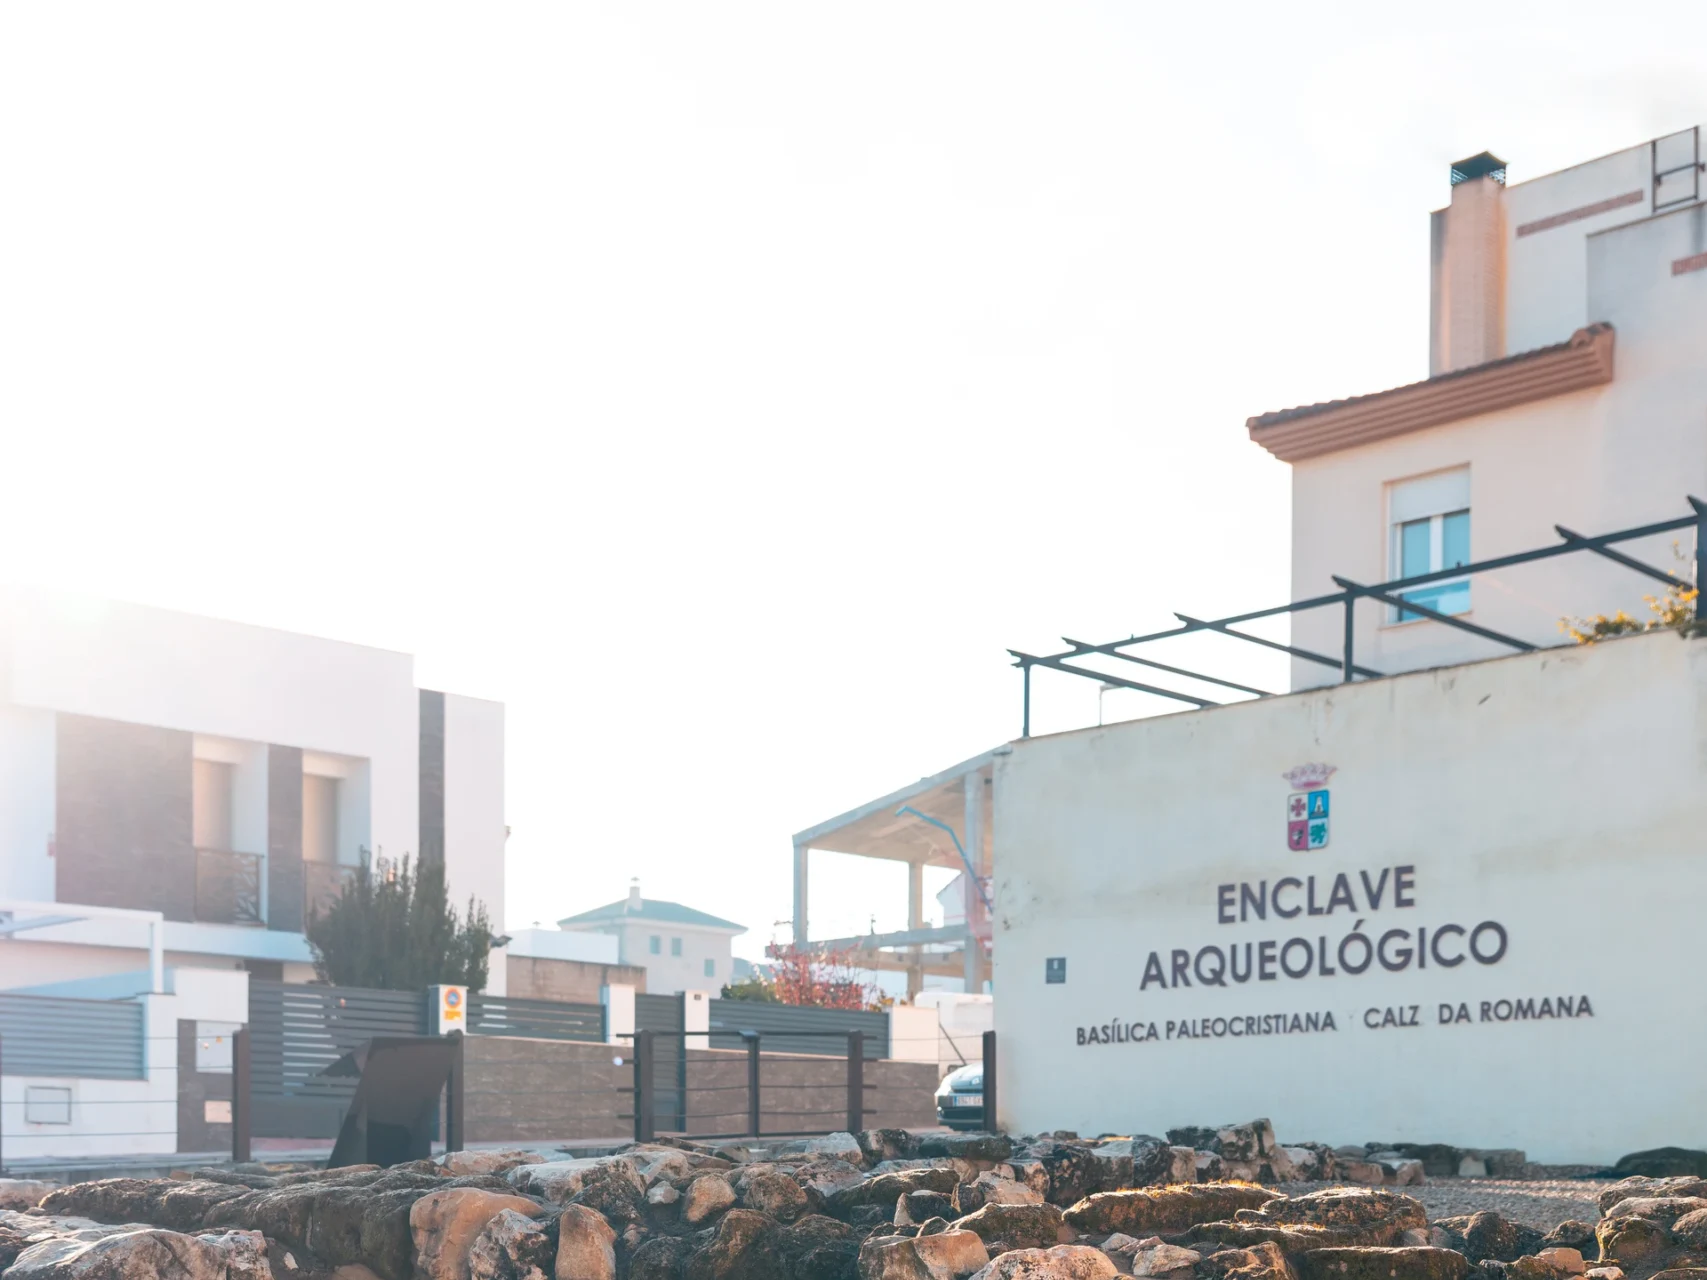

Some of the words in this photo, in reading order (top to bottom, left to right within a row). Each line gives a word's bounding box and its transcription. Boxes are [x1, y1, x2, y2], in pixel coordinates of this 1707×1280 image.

[1218, 865, 1415, 924] ENCLAVE
[1140, 918, 1509, 989] ARQUEOLÓGICO
[1076, 1016, 1160, 1046] BASÍLICA
[1165, 1010, 1337, 1041] PALEOCRISTIANA
[1479, 995, 1594, 1023] ROMANA
